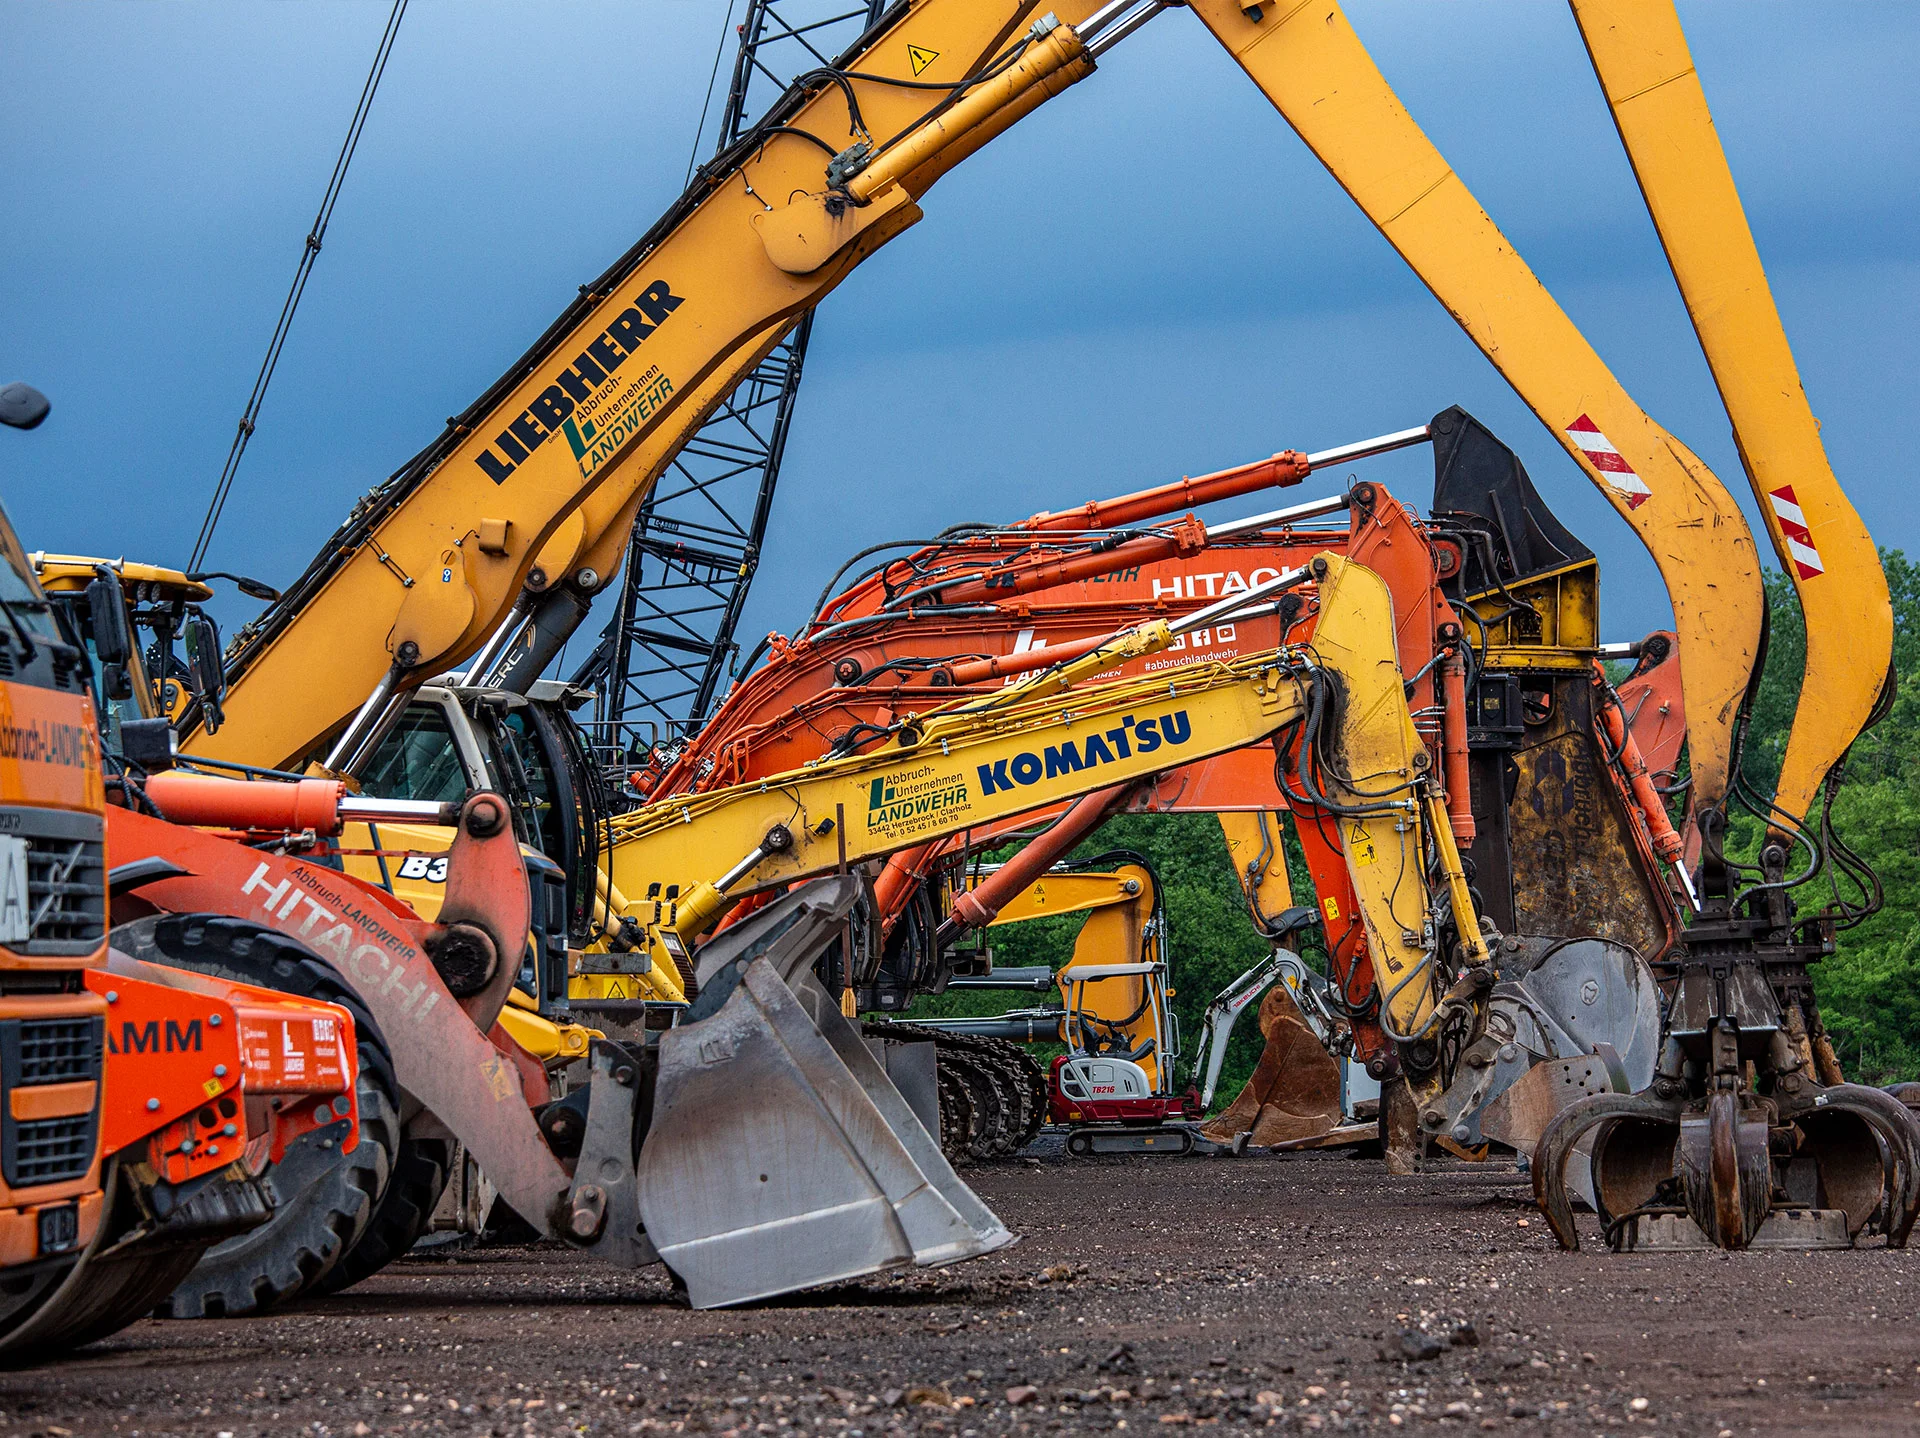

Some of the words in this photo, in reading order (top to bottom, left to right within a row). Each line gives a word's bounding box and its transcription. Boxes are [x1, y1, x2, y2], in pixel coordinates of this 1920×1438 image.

[474, 280, 686, 486] LIEBHERR
[577, 376, 622, 423] Abbruch-
[595, 364, 659, 427] Unternehmen
[580, 377, 674, 478] LANDWEHR
[1152, 565, 1289, 600] HITAC
[1144, 648, 1238, 671] #abbruchlandwehr
[977, 709, 1192, 797] KOMATSU
[885, 765, 936, 787] Abbruch-
[896, 773, 963, 798] Unternehmen
[867, 787, 967, 828] LANDWEHR
[868, 824, 890, 836] 33442
[891, 812, 935, 829] Herzebrock
[940, 803, 972, 817] Clarholz
[885, 830, 899, 839] Tel.
[900, 828, 905, 836] 0
[907, 825, 916, 834] 52
[917, 822, 927, 831] 45
[932, 819, 938, 827] 8
[938, 816, 948, 825] 60
[949, 814, 959, 823] 70
[291, 866, 417, 962] Abbruch-LANDWEHR
[241, 861, 441, 1025] HITACHI
[1092, 1086, 1115, 1094] TB216
